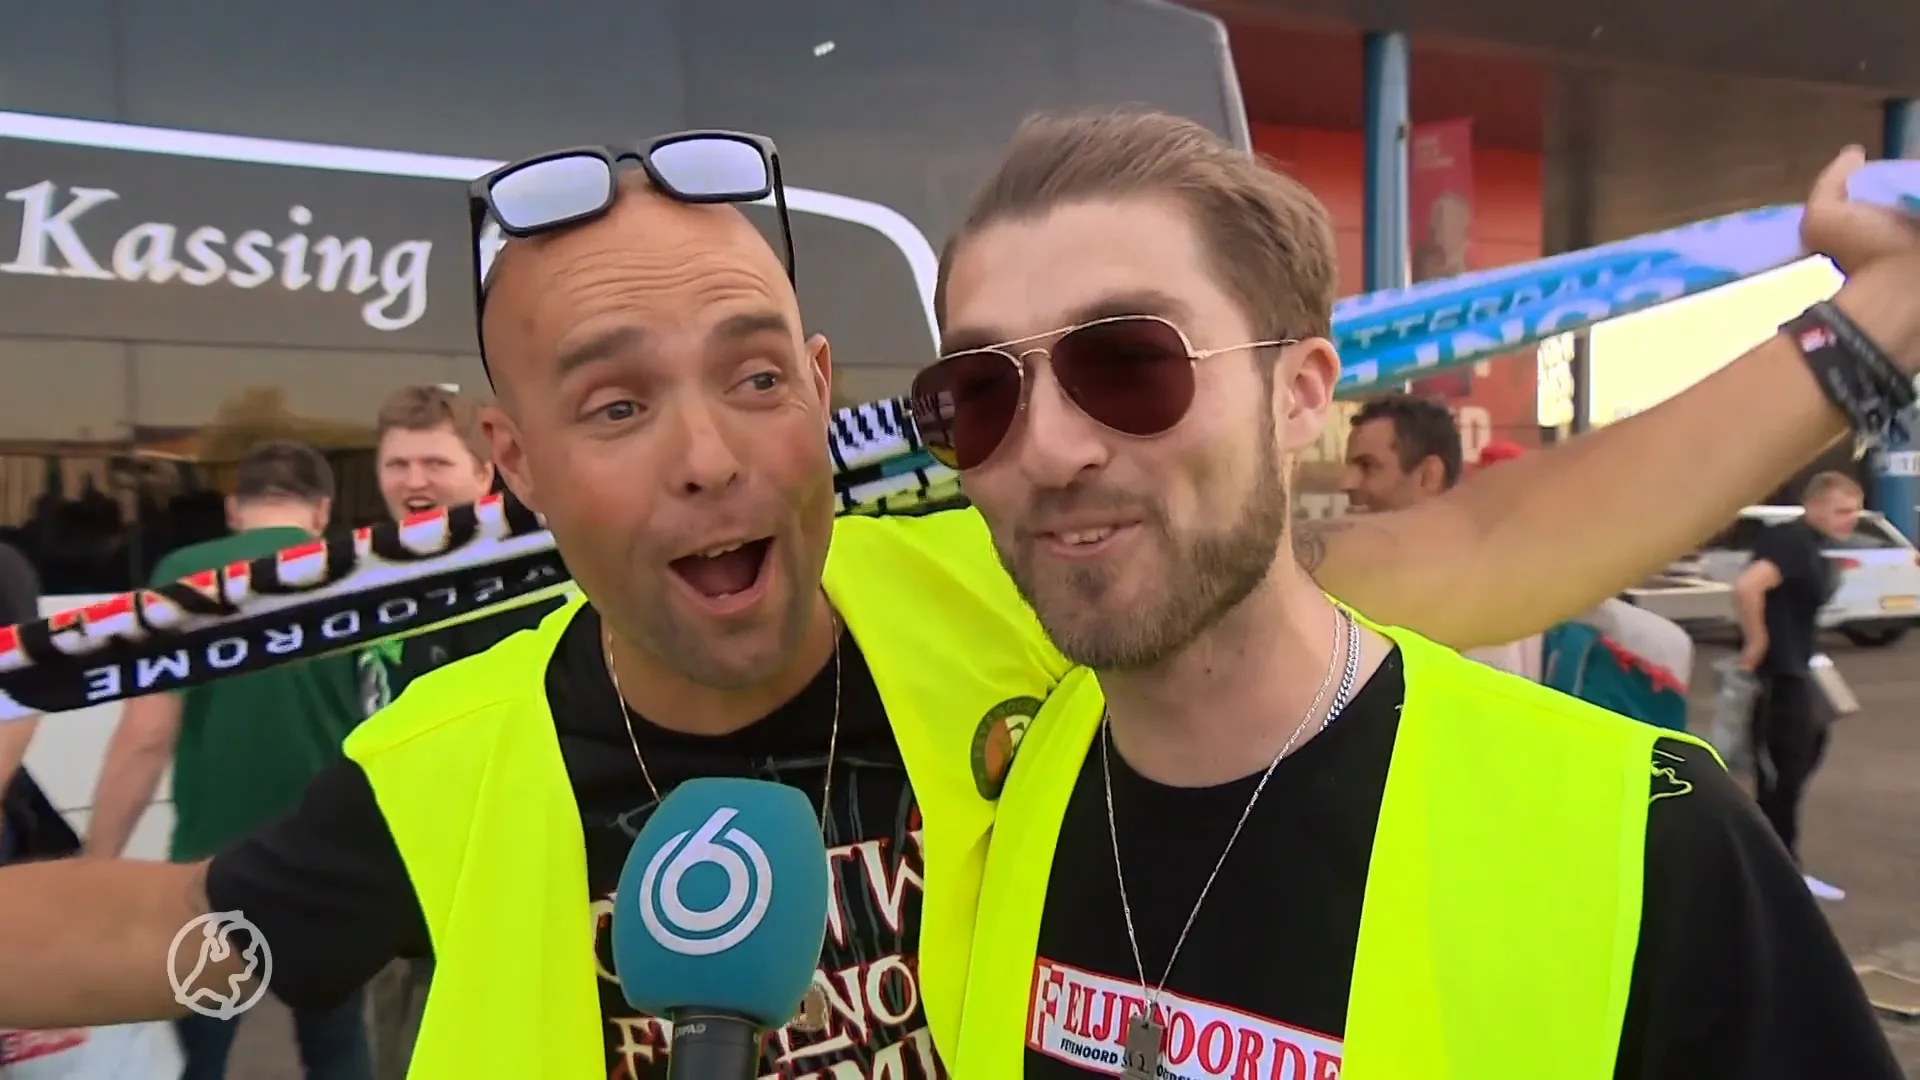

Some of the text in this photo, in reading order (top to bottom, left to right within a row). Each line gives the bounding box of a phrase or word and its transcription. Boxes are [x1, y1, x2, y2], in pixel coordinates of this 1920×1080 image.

[1, 180, 433, 330] Kassing
[84, 564, 557, 701] VELODROME
[639, 807, 773, 955] 6
